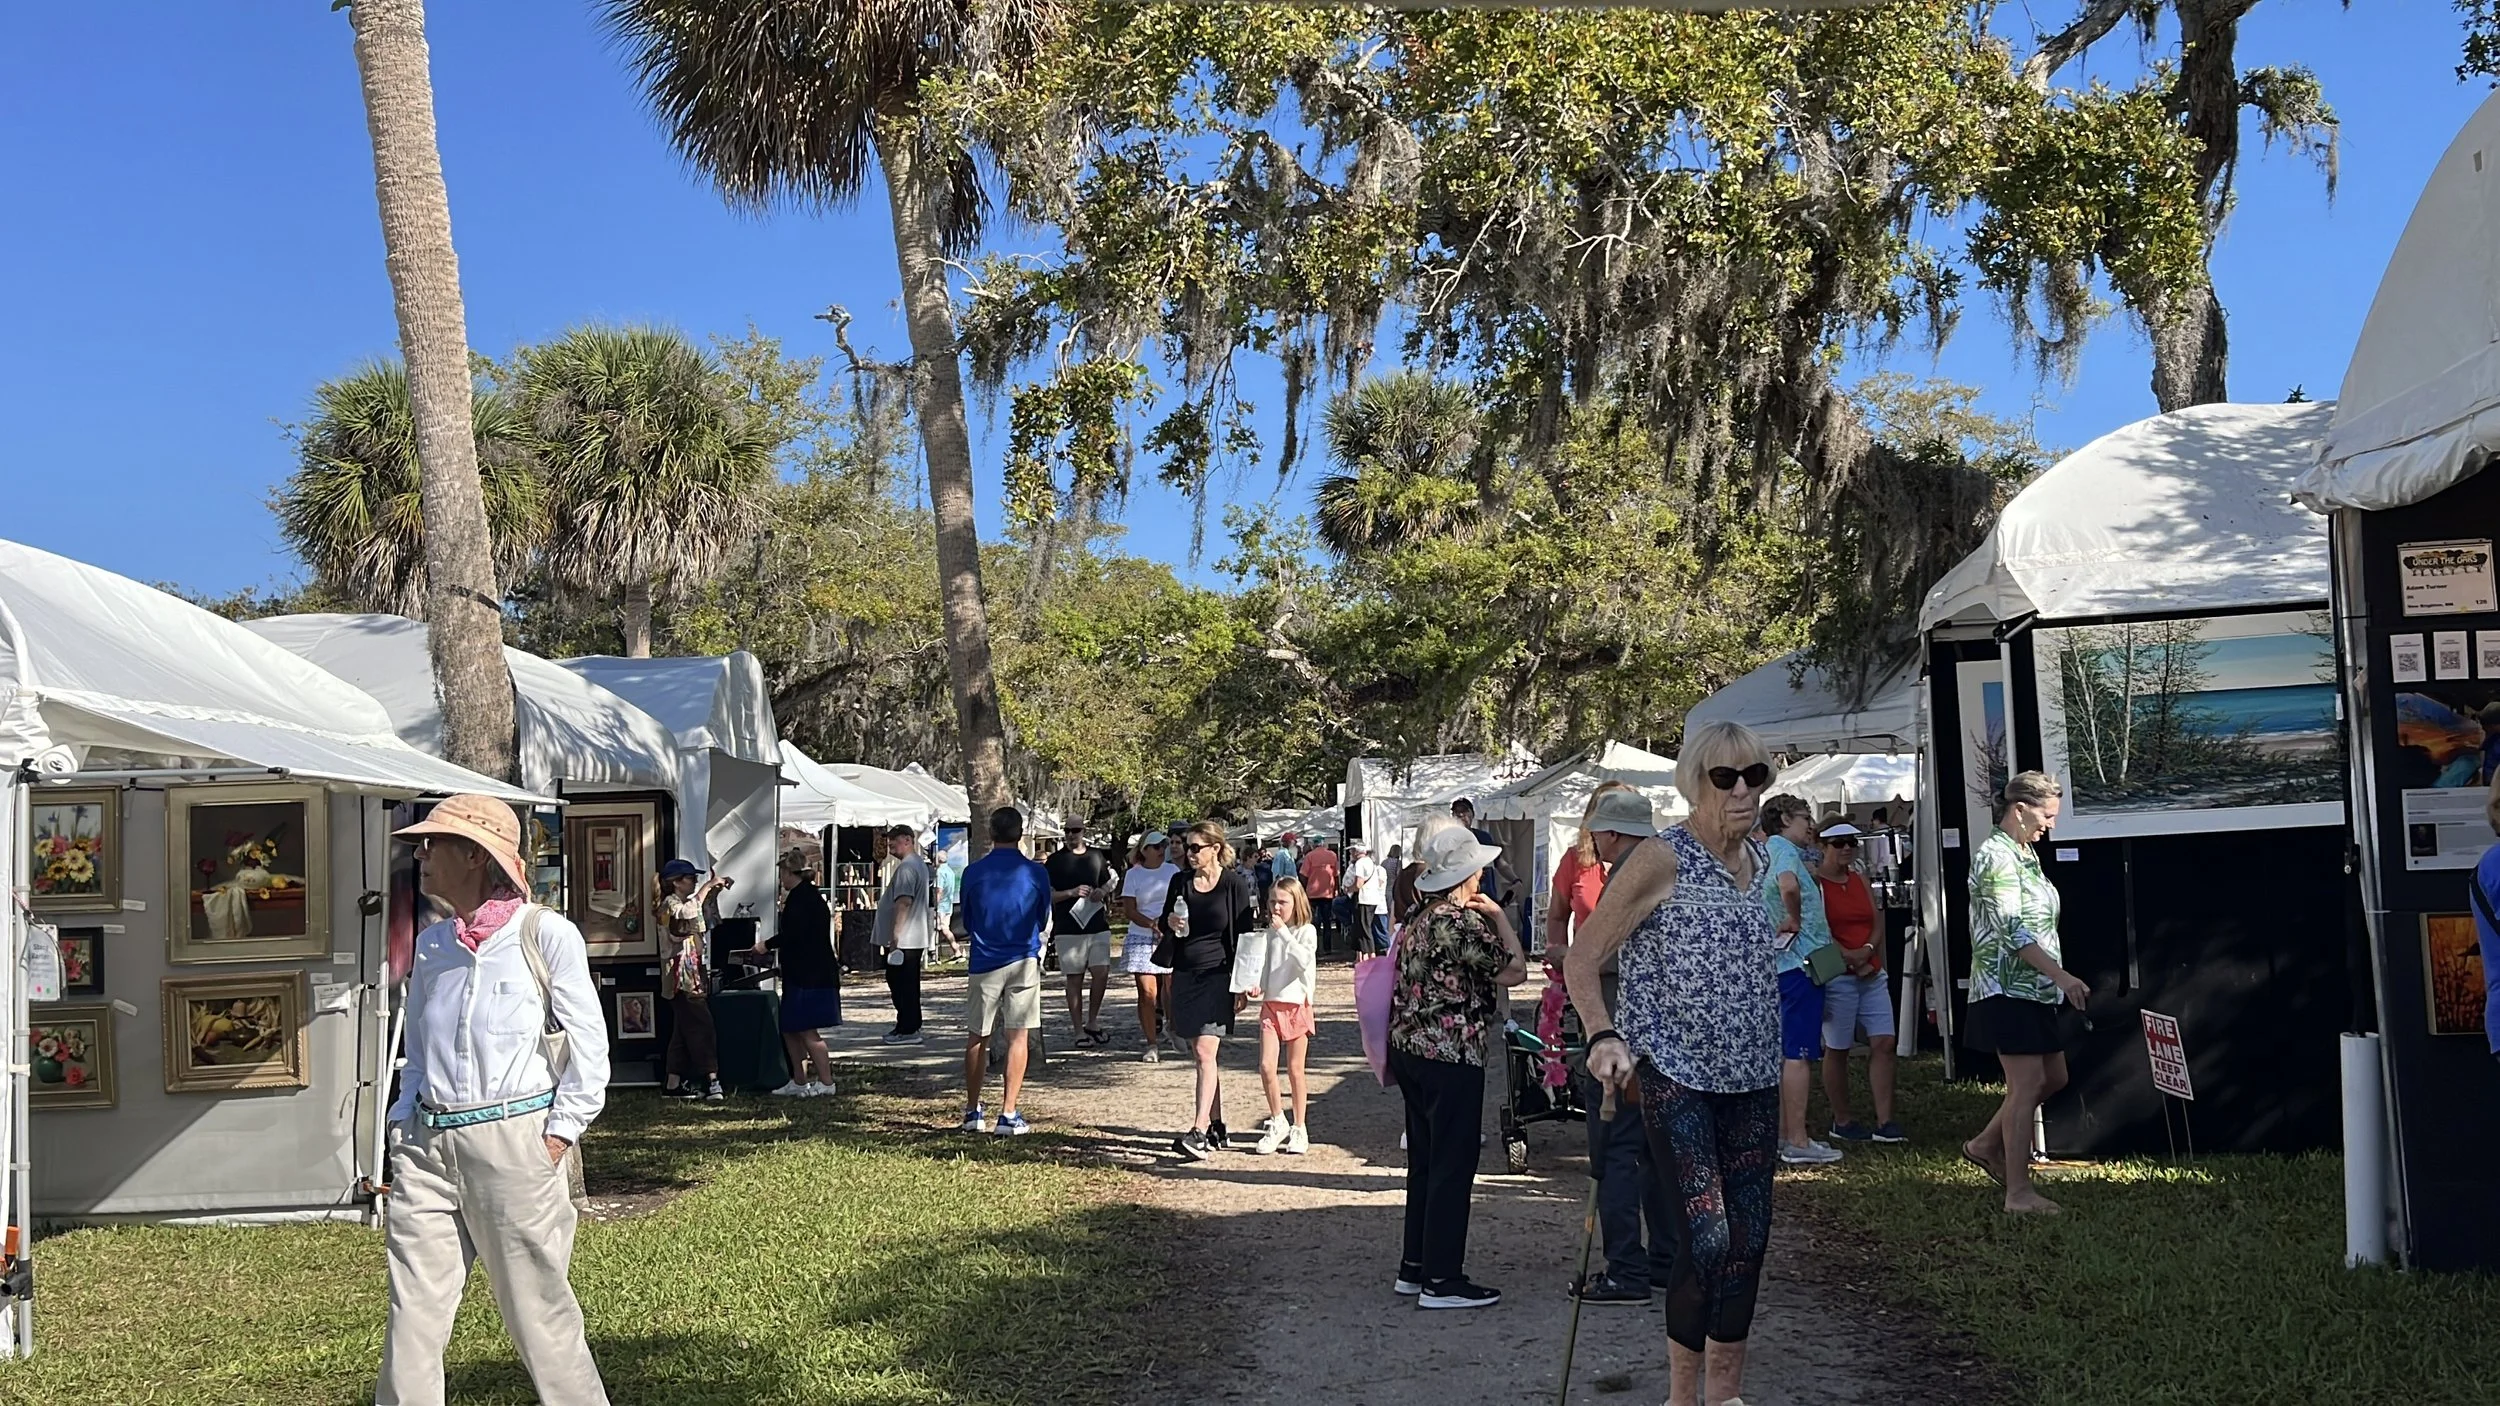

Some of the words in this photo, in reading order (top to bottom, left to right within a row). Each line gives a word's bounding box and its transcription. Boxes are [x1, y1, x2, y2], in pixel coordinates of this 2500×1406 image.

[2412, 557, 2438, 566] UNDER
[2441, 556, 2455, 564] THE
[2457, 555, 2478, 564] OAKS
[2144, 1015, 2175, 1039] FIRE
[2147, 1037, 2183, 1064] LANE
[2154, 1058, 2181, 1076] KEEP
[2154, 1071, 2187, 1090] CLEAR
